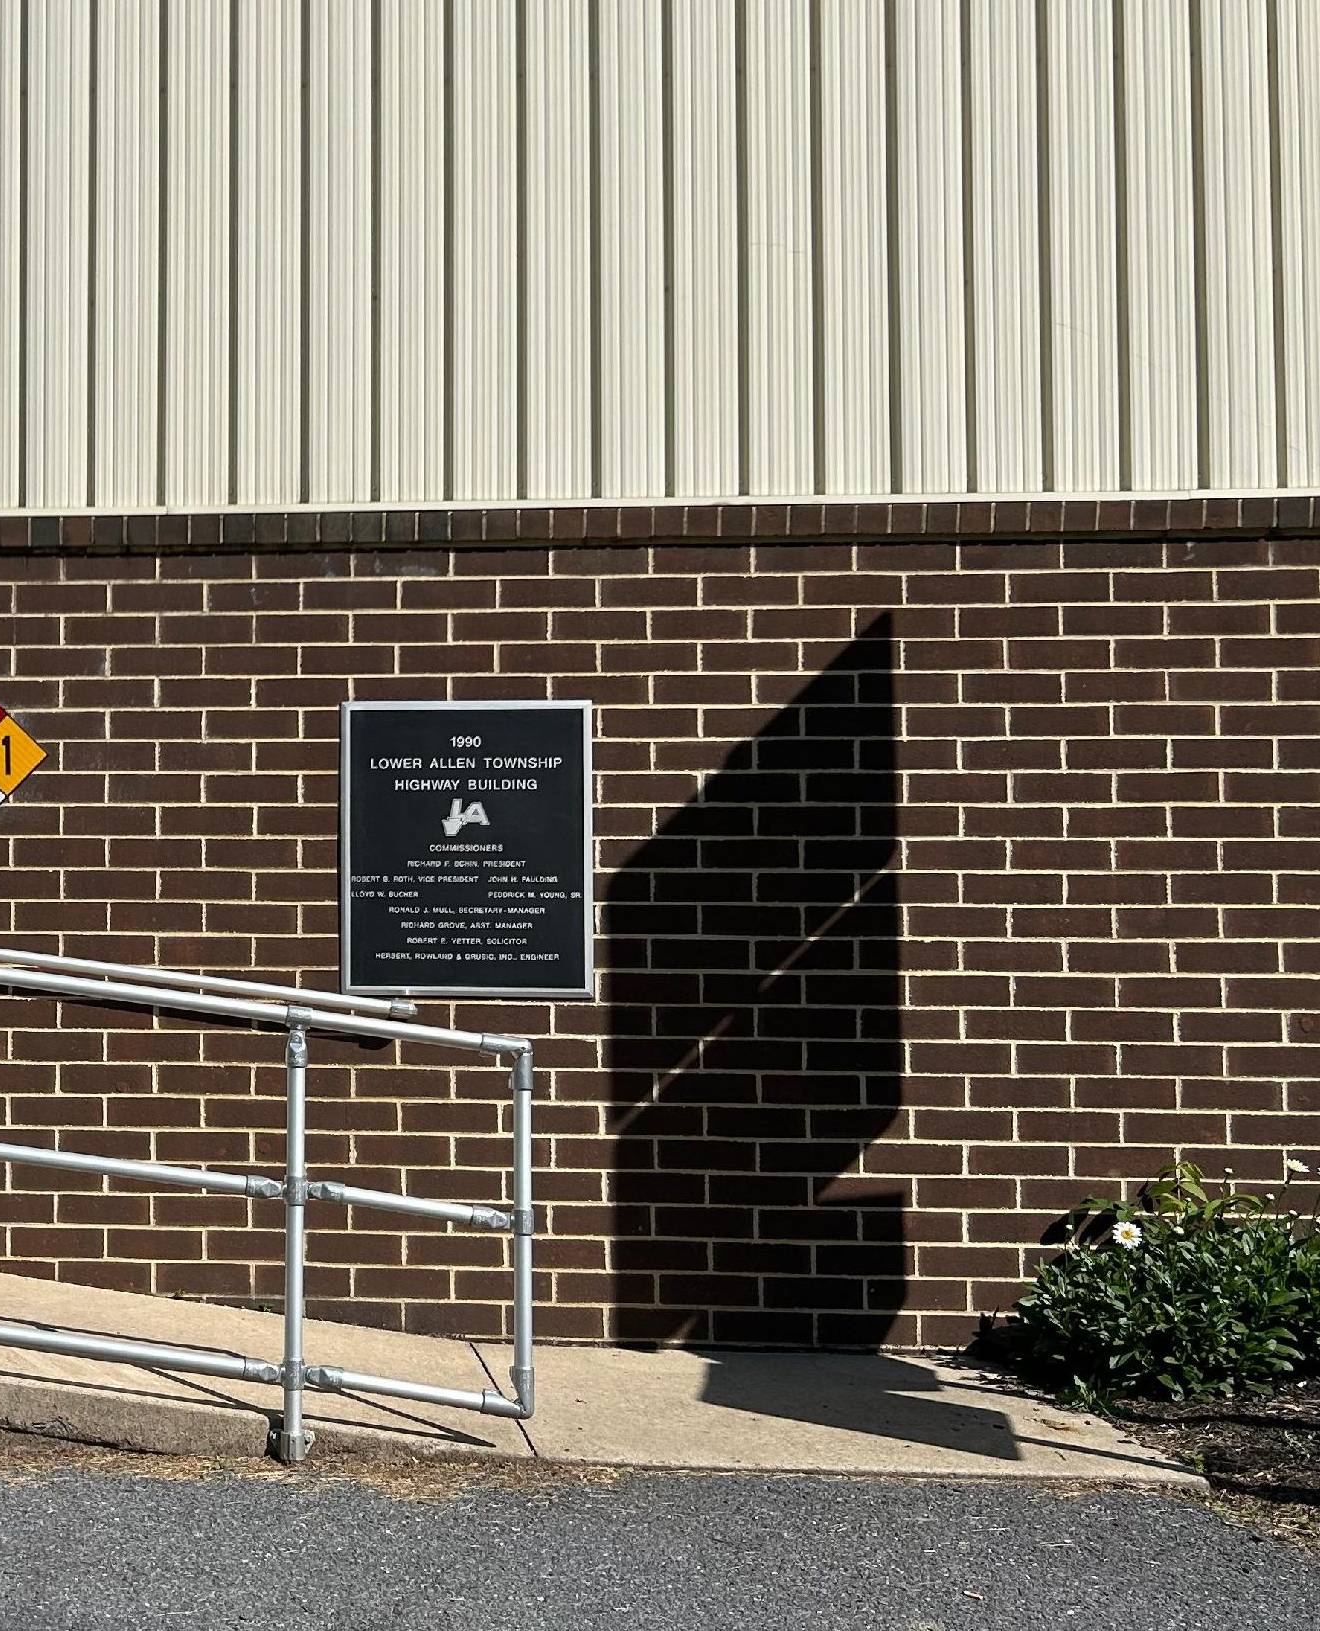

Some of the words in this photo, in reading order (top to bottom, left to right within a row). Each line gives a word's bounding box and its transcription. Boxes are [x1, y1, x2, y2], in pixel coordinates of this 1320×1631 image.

[449, 735, 482, 748] 1990
[1, 735, 12, 776] 1
[370, 757, 422, 770] LOWER
[429, 757, 476, 769] ALLEN
[482, 756, 563, 769] TOWNSHIP
[394, 779, 461, 791] HIGHWAY
[467, 779, 538, 791] BUILDING
[429, 844, 504, 852] COMMISSIONERS
[407, 860, 442, 868] RICHARD
[482, 860, 527, 868] PRESIDENT
[351, 875, 381, 883] ROBERT
[418, 875, 436, 883] VICE
[437, 875, 480, 883] PRESIDENT
[487, 875, 508, 883] JOHN
[351, 890, 375, 898] LLOYD
[388, 906, 421, 914] RONALD
[400, 921, 436, 929] RICHARD
[486, 937, 528, 945] SOLICITOR
[414, 952, 454, 960] ROWLAND
[520, 953, 560, 961] ENGINEER
